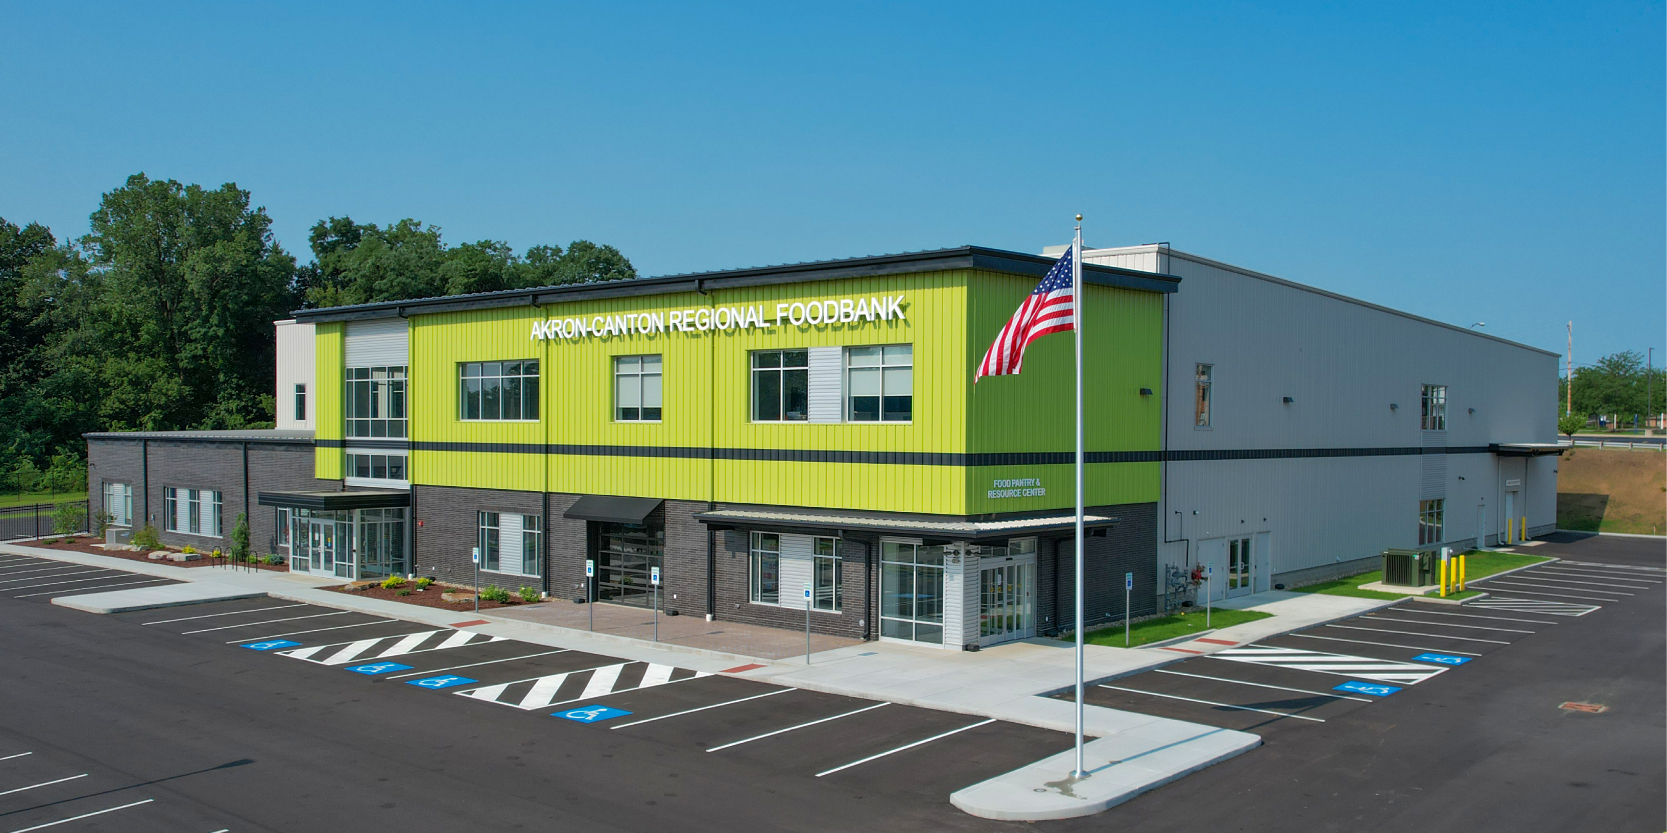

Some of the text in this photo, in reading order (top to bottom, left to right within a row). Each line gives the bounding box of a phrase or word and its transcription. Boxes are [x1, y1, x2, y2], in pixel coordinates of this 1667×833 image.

[530, 295, 906, 340] AKRON-CANTON REGIONAL FOODBANK
[993, 478, 1041, 488] FOOD PANTRY &
[987, 488, 1046, 499] RESOURCE CENTER
